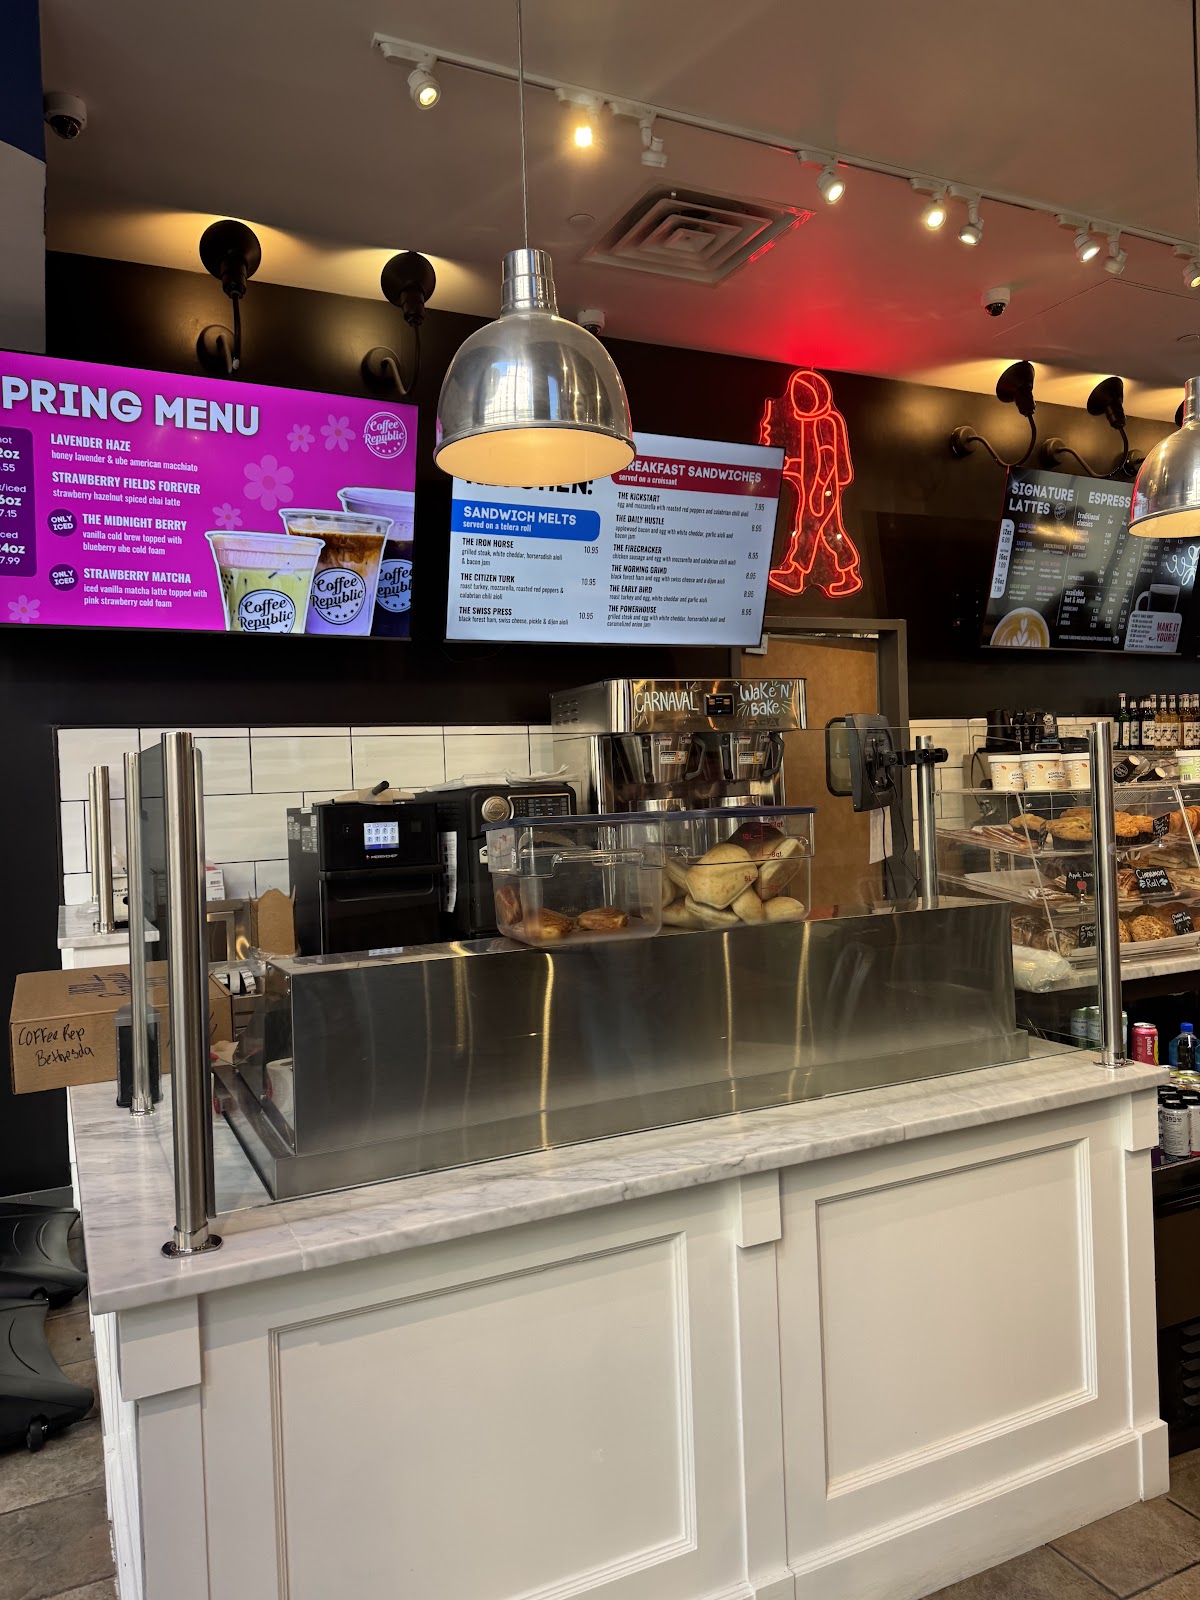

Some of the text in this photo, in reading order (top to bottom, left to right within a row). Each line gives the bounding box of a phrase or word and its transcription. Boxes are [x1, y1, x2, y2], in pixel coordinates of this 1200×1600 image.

[1, 375, 258, 435] PRING MENU
[369, 419, 399, 434] Coffee
[50, 432, 131, 452] LAVENDER HAZE
[363, 430, 405, 445] Republic
[0, 462, 15, 472] .55
[51, 449, 198, 472] honey lavender & ube american macchiato
[624, 460, 761, 483] REAKFAST SANDWICHES
[51, 471, 200, 494] STRAWBERRY FIELDS FOREVER
[618, 473, 638, 482] served
[651, 476, 677, 485] croissant
[52, 488, 180, 506] strawberry hazelnut spiced chai latte
[618, 491, 660, 502] THE KICKSTART
[1012, 482, 1131, 508] SIGNATURE ESPRESS
[1009, 498, 1050, 515] LATTES
[82, 513, 186, 530] THE MIDNIGHT BERRY
[463, 505, 576, 525] SANDWICH MELTS
[615, 514, 664, 525] THE DAILY HUSTLE
[462, 520, 484, 528] served
[500, 522, 519, 531] telera
[520, 524, 531, 532] roll
[82, 530, 182, 544] vanilla cold brew topped with
[462, 537, 513, 548] THE IRON HORSE
[0, 542, 25, 554] 4oz
[82, 541, 165, 555] blueberry ube cold foam
[506, 550, 525, 559] cheddar,
[526, 552, 552, 560] horseradish
[613, 543, 662, 554] THE FIRECRACKER
[52, 570, 73, 578] ONLY
[83, 567, 191, 583] STRAWBERRY MATCHA
[611, 564, 667, 574] THE MORNING GRIND
[460, 572, 515, 583] THE CITIZEN TURK
[83, 583, 207, 598] iced vanilla matcha latte topped with
[314, 577, 358, 595] Coffee
[609, 584, 619, 592] THE
[83, 595, 172, 607] pink strawberry cold foam
[310, 590, 364, 609] Republic
[243, 598, 287, 617] Coffee
[458, 606, 512, 615] THE SWISS PRESS
[619, 605, 656, 613] POWERHOUSE
[238, 610, 293, 630] Republic
[1157, 622, 1173, 632] MAKE
[634, 691, 699, 713] CARNAVAL
[1136, 869, 1165, 880] Cinnamon
[1146, 879, 1160, 888] Roll
